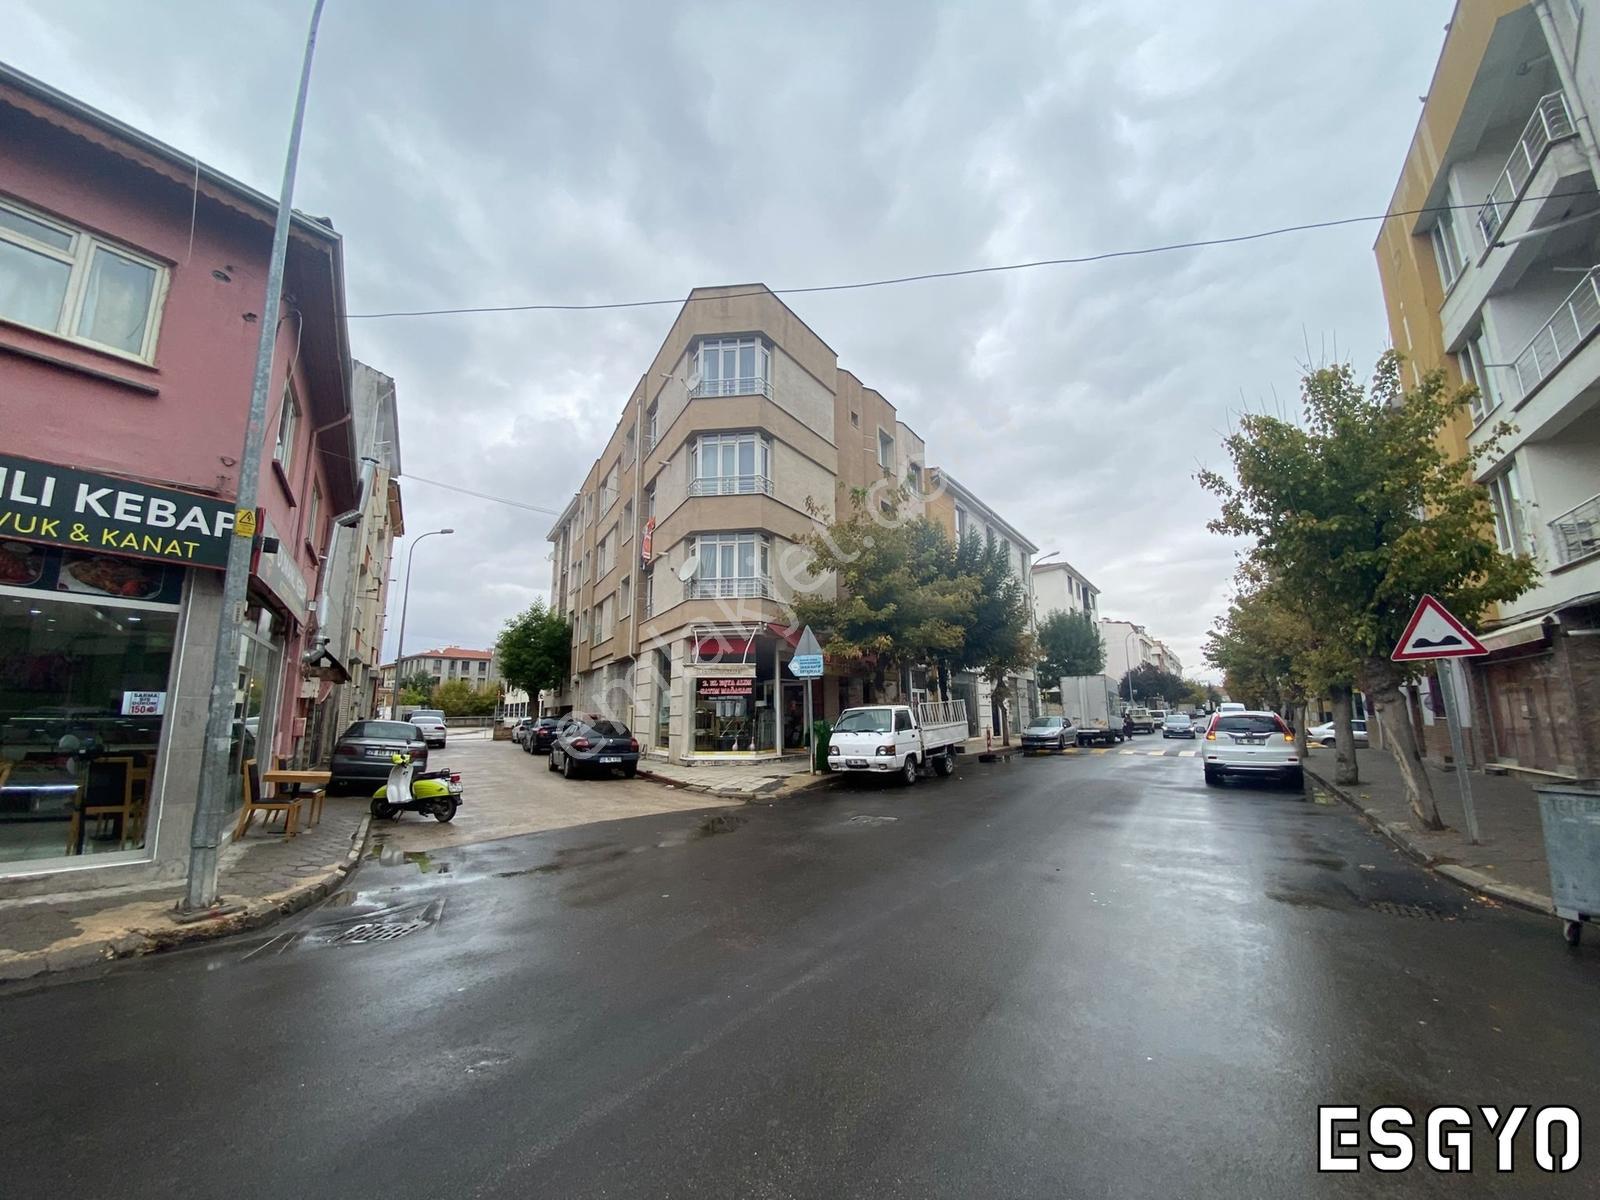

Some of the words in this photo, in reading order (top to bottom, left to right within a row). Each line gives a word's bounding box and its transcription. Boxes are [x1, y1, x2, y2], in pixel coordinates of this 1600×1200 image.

[75, 484, 235, 537] KEBAP
[69, 523, 89, 543] &
[102, 528, 200, 559] KANAT
